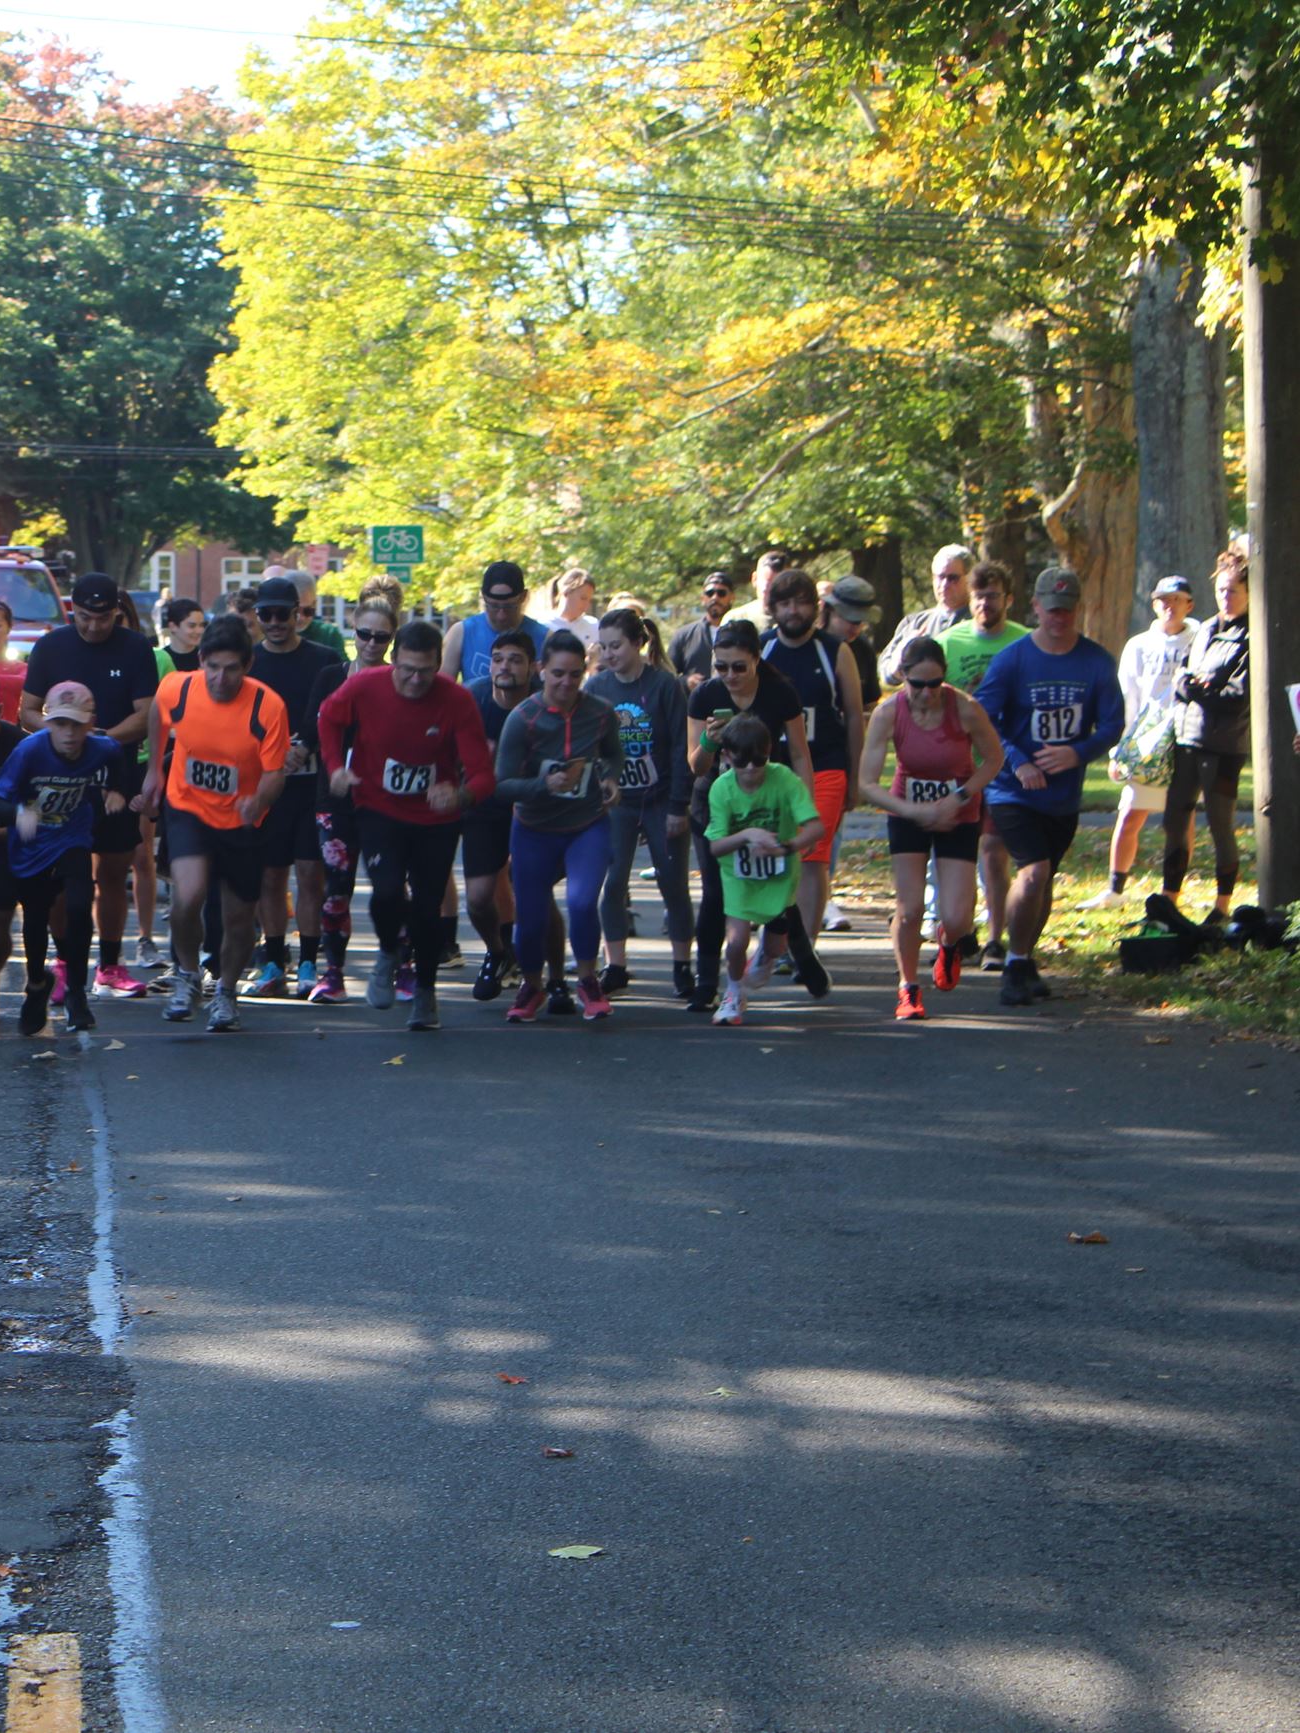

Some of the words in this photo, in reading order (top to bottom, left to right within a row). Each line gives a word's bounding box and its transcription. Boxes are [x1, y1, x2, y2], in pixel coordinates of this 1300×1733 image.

[620, 732, 652, 741] RKEY
[1038, 707, 1074, 740] 812
[192, 760, 231, 792] 833
[390, 764, 431, 791] 873
